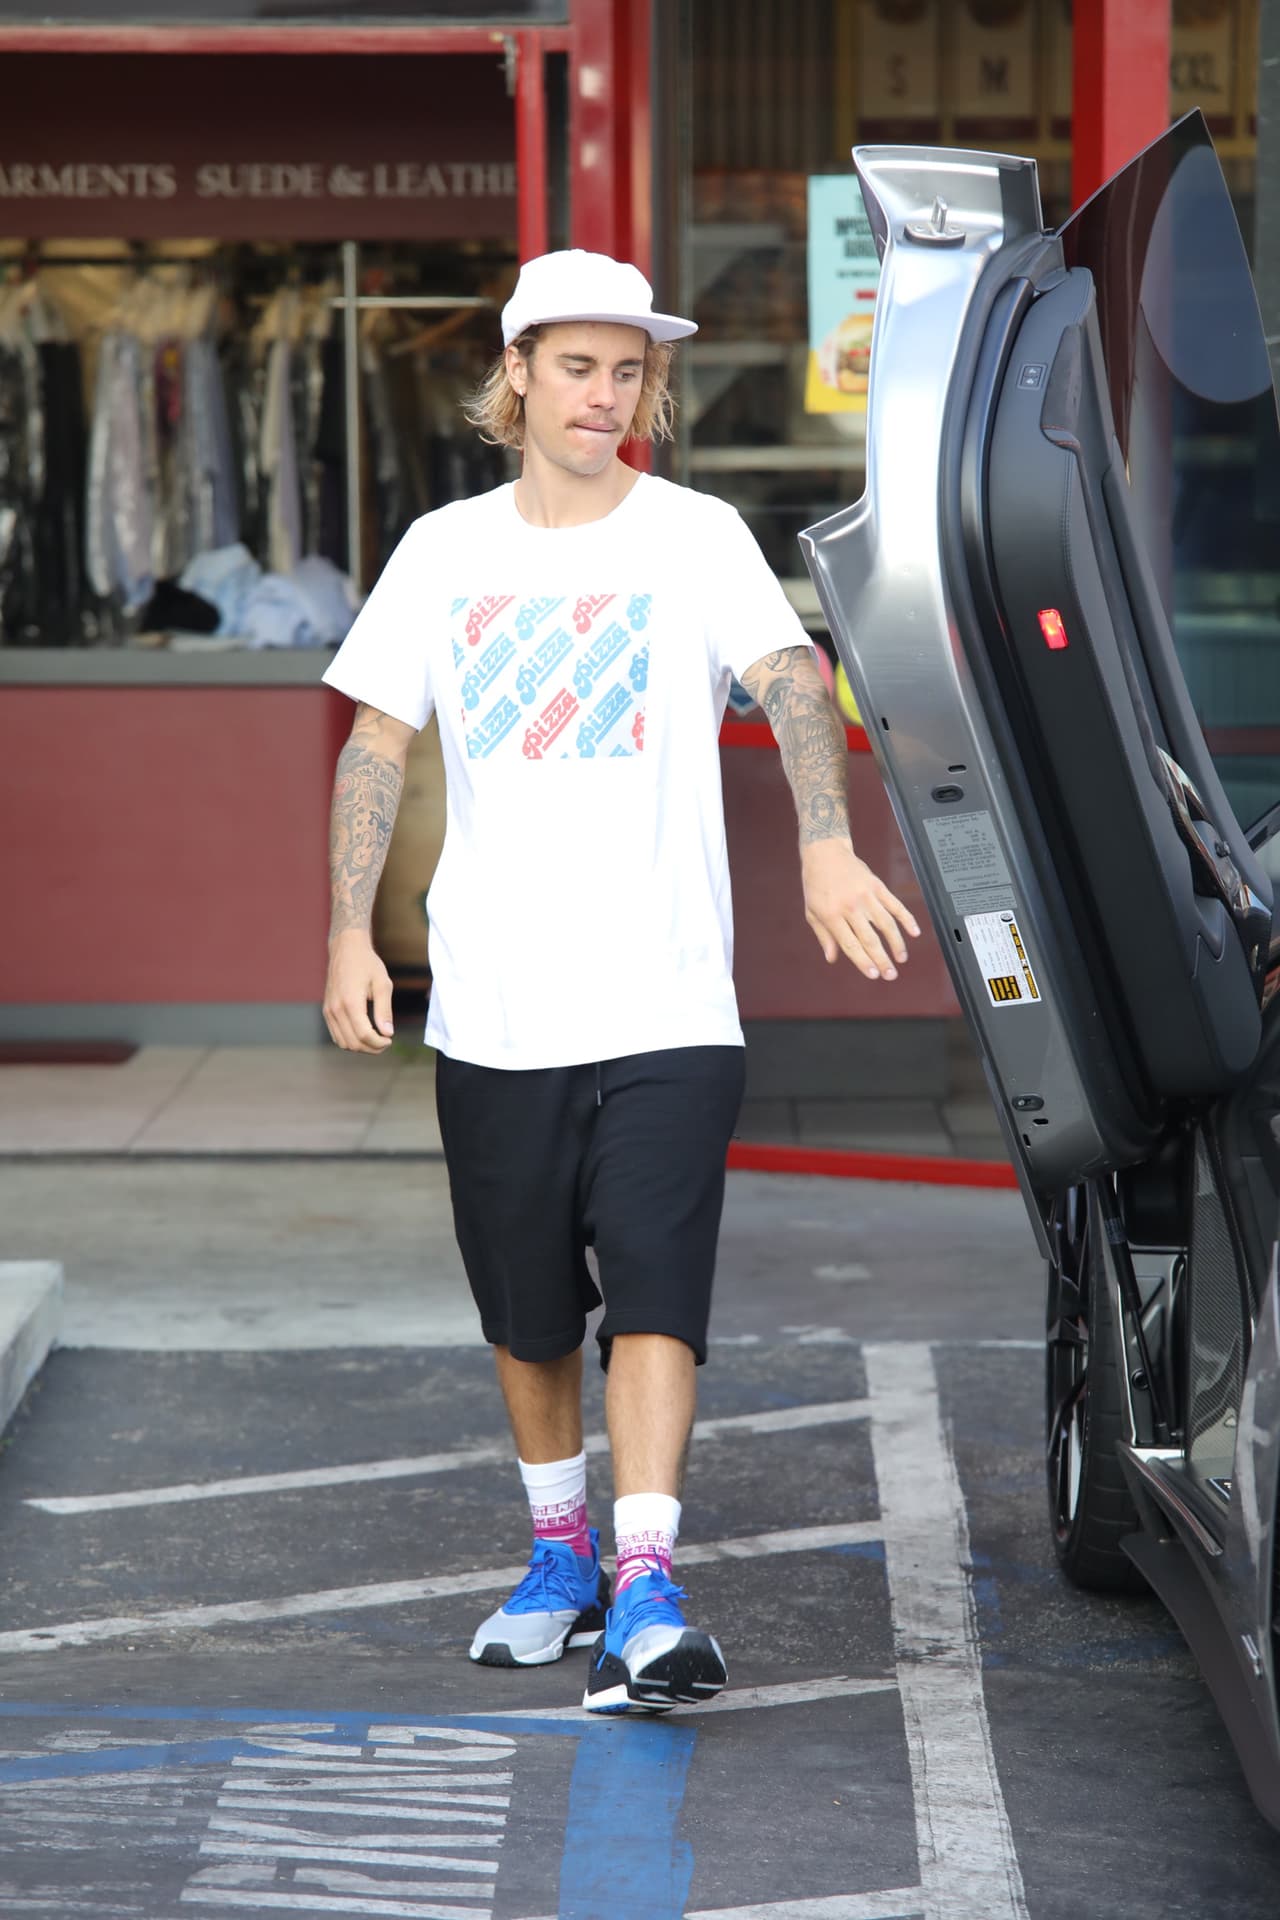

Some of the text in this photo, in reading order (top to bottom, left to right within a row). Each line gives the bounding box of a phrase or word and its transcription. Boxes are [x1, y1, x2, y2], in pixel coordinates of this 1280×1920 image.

[0, 163, 517, 197] ARMENTS SUEDE & LEATHE
[461, 634, 515, 711] Pizza
[516, 629, 573, 705] Pizza
[573, 624, 630, 699] Pizza
[522, 691, 578, 759] Pizza
[576, 685, 632, 758] Pizza
[180, 1723, 517, 1920] RKING
